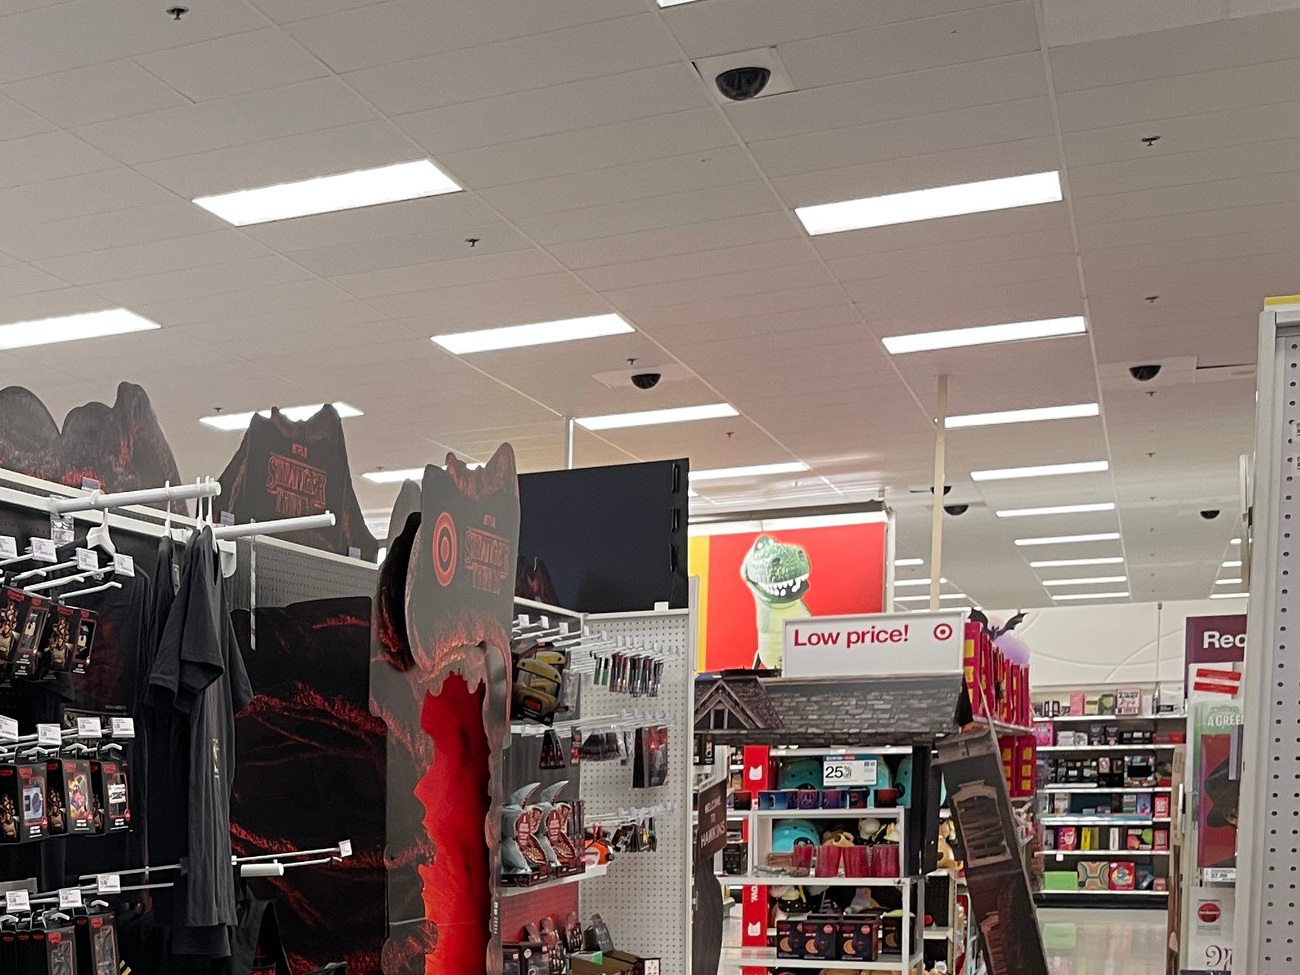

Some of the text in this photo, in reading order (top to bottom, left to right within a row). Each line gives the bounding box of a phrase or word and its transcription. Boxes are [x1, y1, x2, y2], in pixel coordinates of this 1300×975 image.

[267, 454, 327, 508] STRANGER
[464, 527, 509, 578] STRANGER
[793, 625, 909, 649] Low price!
[704, 796, 722, 814] WELCOME
[700, 820, 726, 849] HAWKINS
